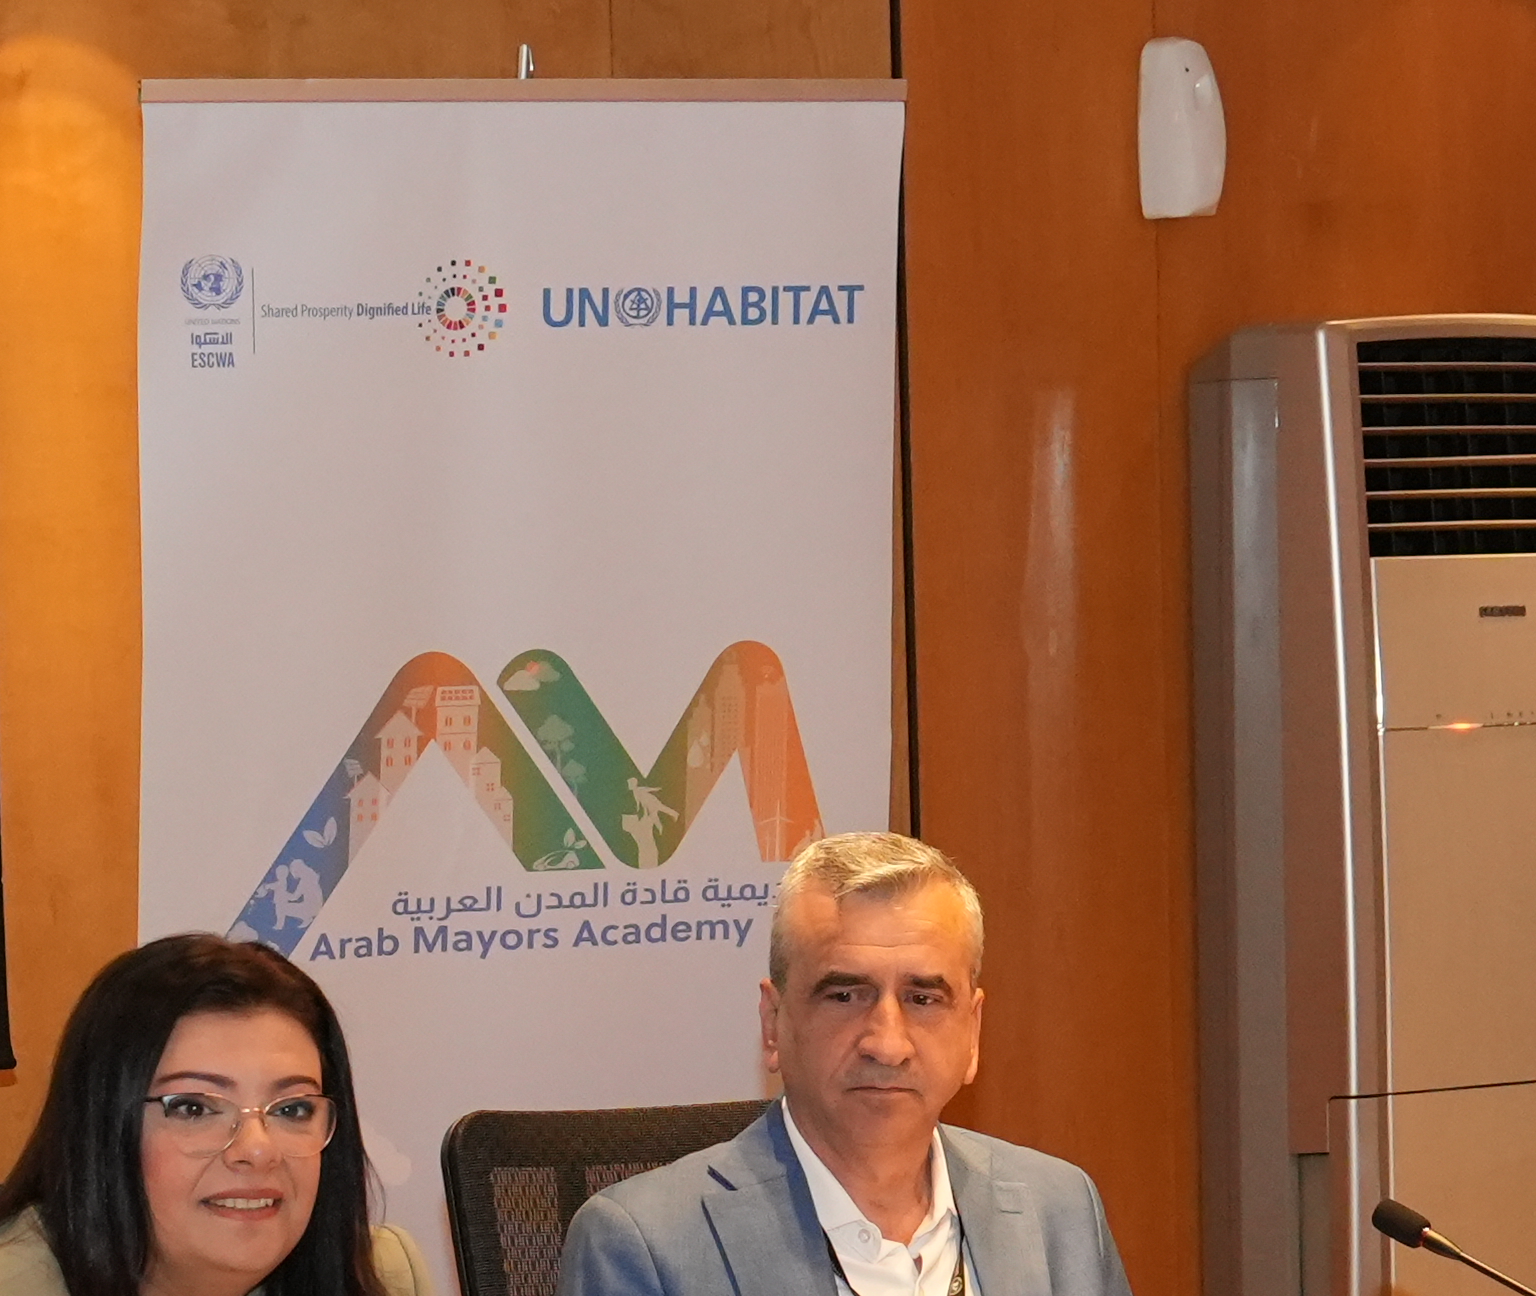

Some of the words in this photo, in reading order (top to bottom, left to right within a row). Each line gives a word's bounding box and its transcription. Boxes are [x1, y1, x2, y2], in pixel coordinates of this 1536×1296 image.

[260, 303, 298, 318] Shared
[300, 303, 354, 320] Prosperity
[356, 301, 408, 319] Dignified
[410, 301, 432, 316] Life
[665, 285, 864, 327] HABITAT
[191, 352, 235, 368] ESCWA
[391, 885, 503, 920] العربية
[514, 881, 610, 918] المدن
[619, 877, 690, 906] قادة
[309, 929, 400, 961] Arab
[413, 924, 560, 961] Mayors
[572, 914, 755, 949] Academy
